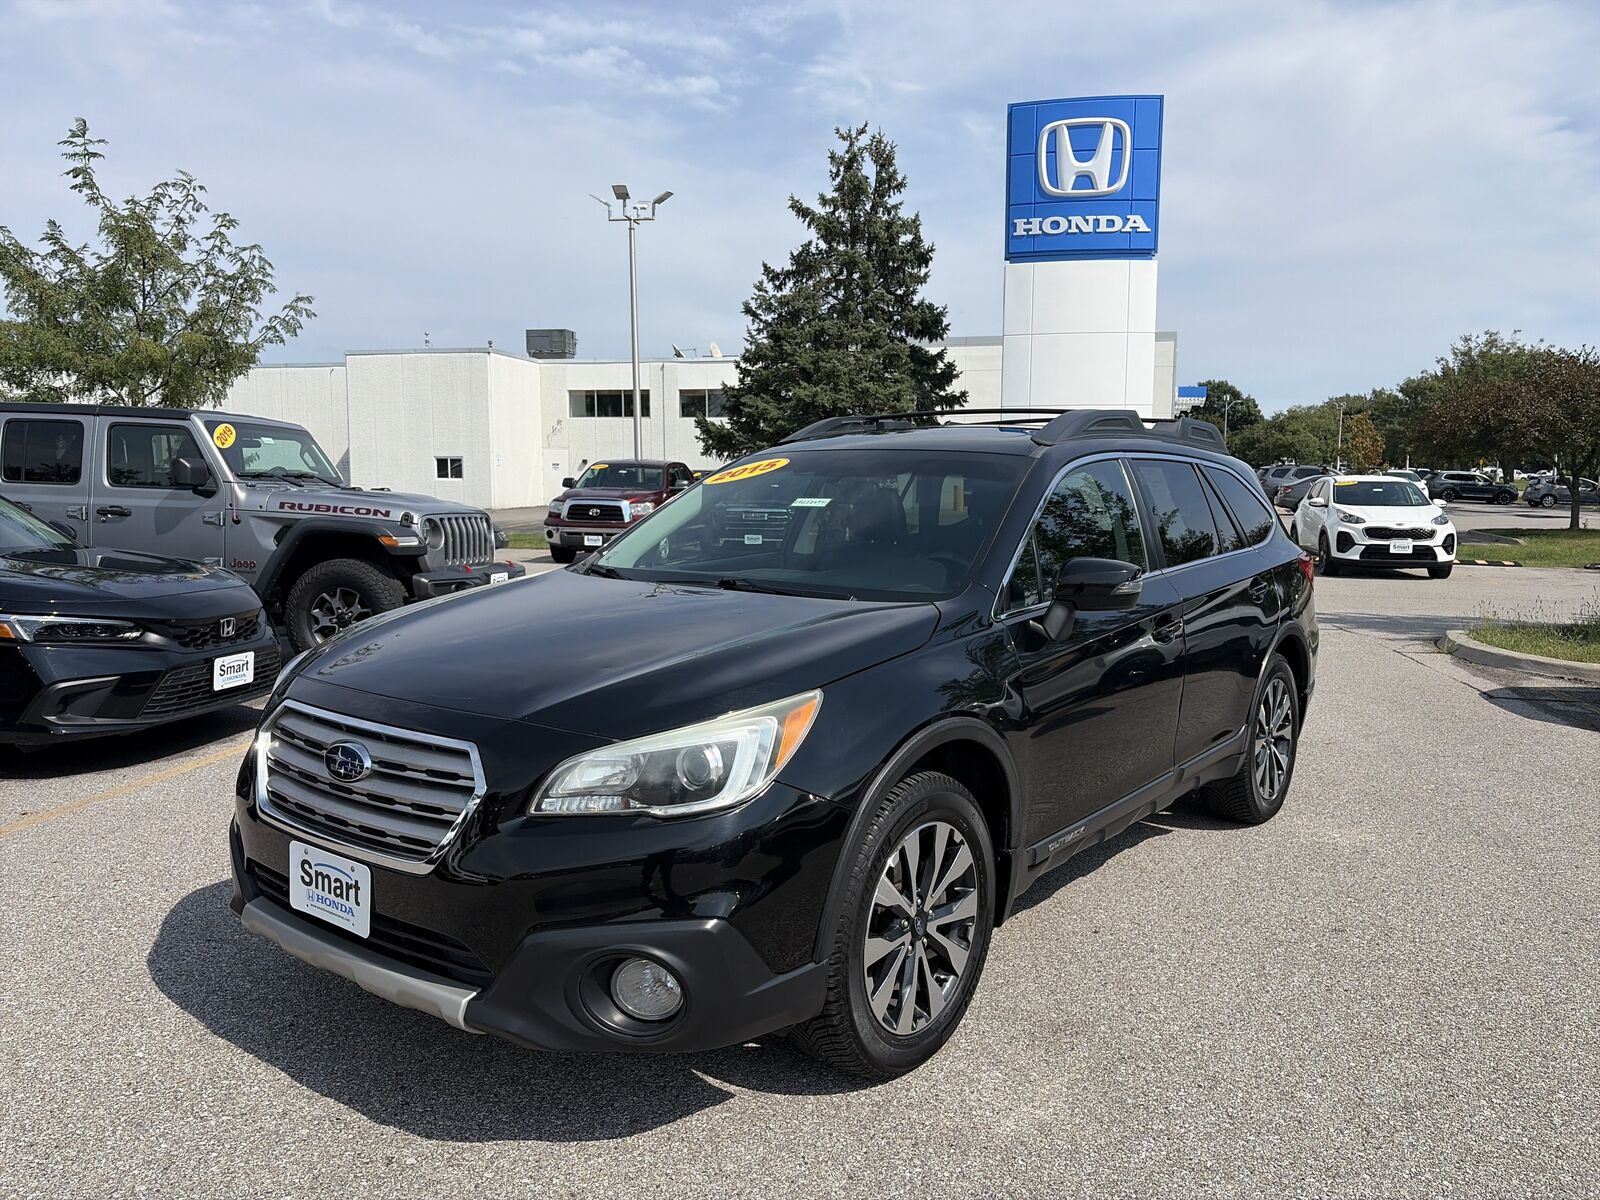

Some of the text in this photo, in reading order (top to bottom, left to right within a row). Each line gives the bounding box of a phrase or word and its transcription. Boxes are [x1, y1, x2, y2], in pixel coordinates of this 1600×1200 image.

[1013, 214, 1151, 236] HONDA
[216, 425, 233, 446] 2019
[711, 460, 781, 482] 2015
[279, 502, 391, 518] RUBICON
[230, 558, 256, 569] Jeep
[219, 660, 248, 676] Smart
[226, 673, 246, 681] HONDA
[300, 859, 361, 907] Smart
[316, 893, 355, 917] HONDA
